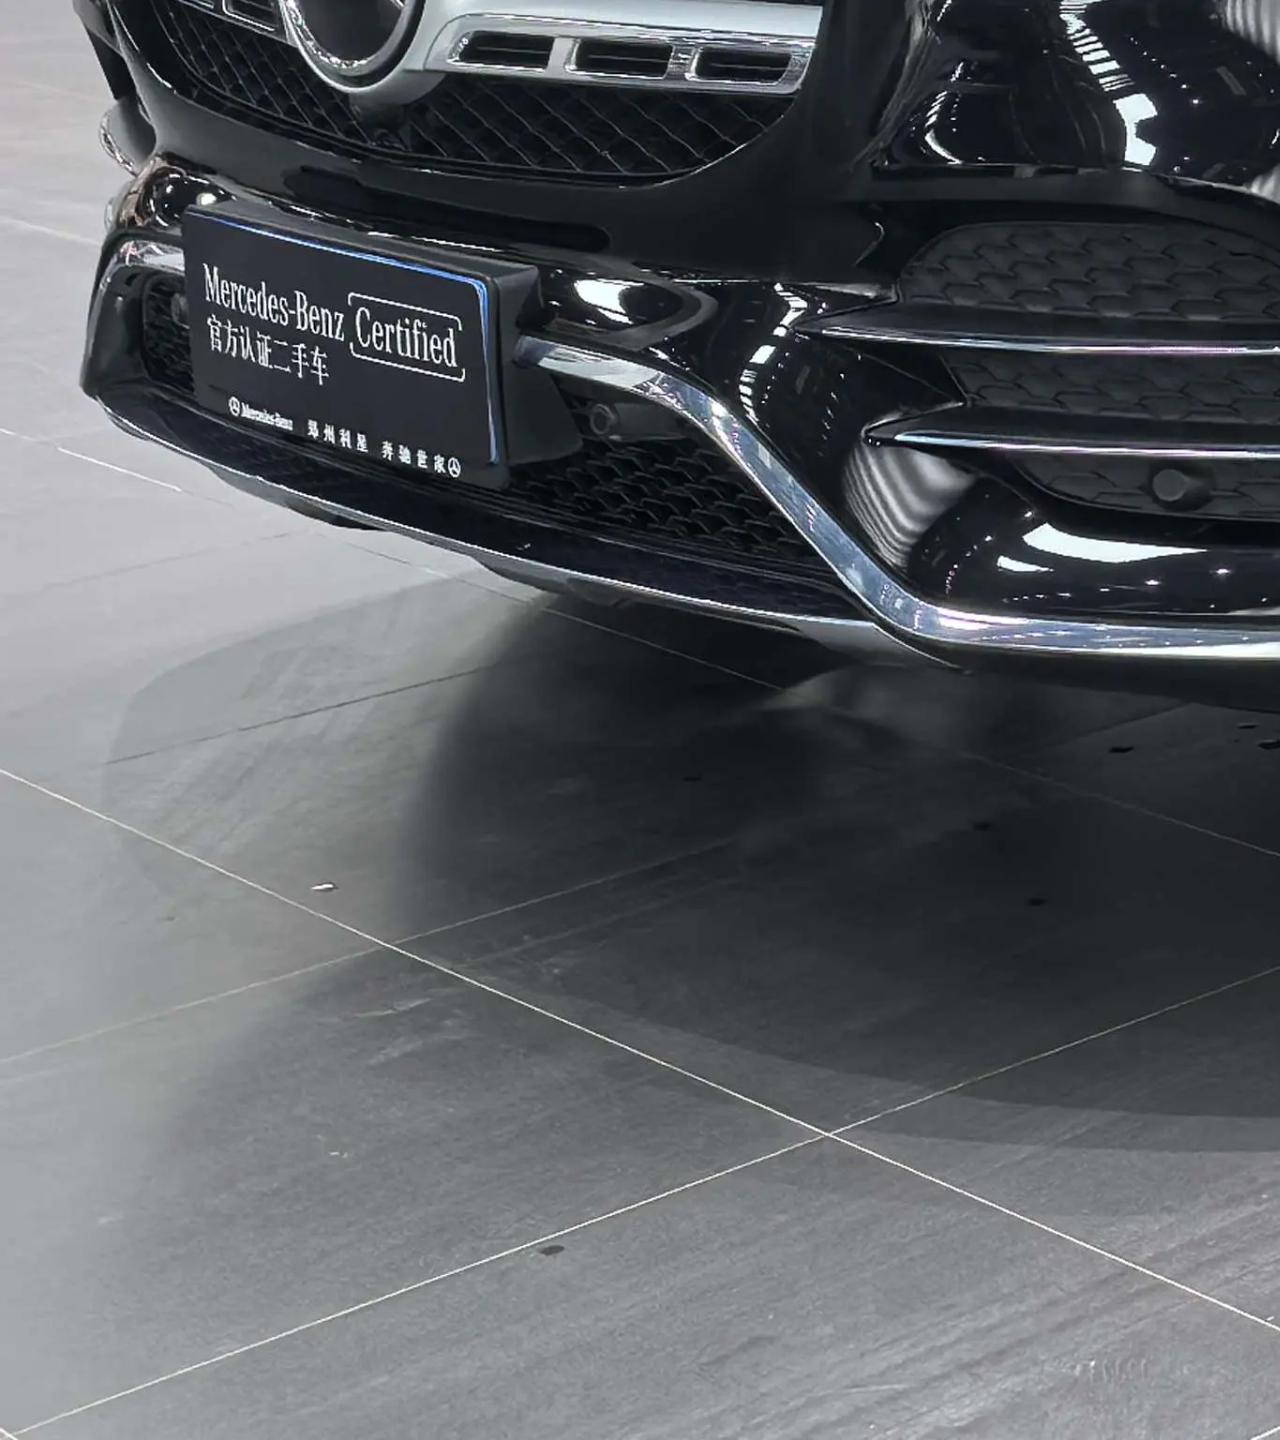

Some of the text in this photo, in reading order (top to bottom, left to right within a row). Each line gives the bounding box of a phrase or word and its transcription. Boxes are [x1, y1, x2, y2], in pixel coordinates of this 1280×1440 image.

[202, 262, 457, 368] Mercedes-Benz Certified
[207, 314, 329, 386] 官方认证二手车
[381, 440, 446, 474] 奔驰世家
